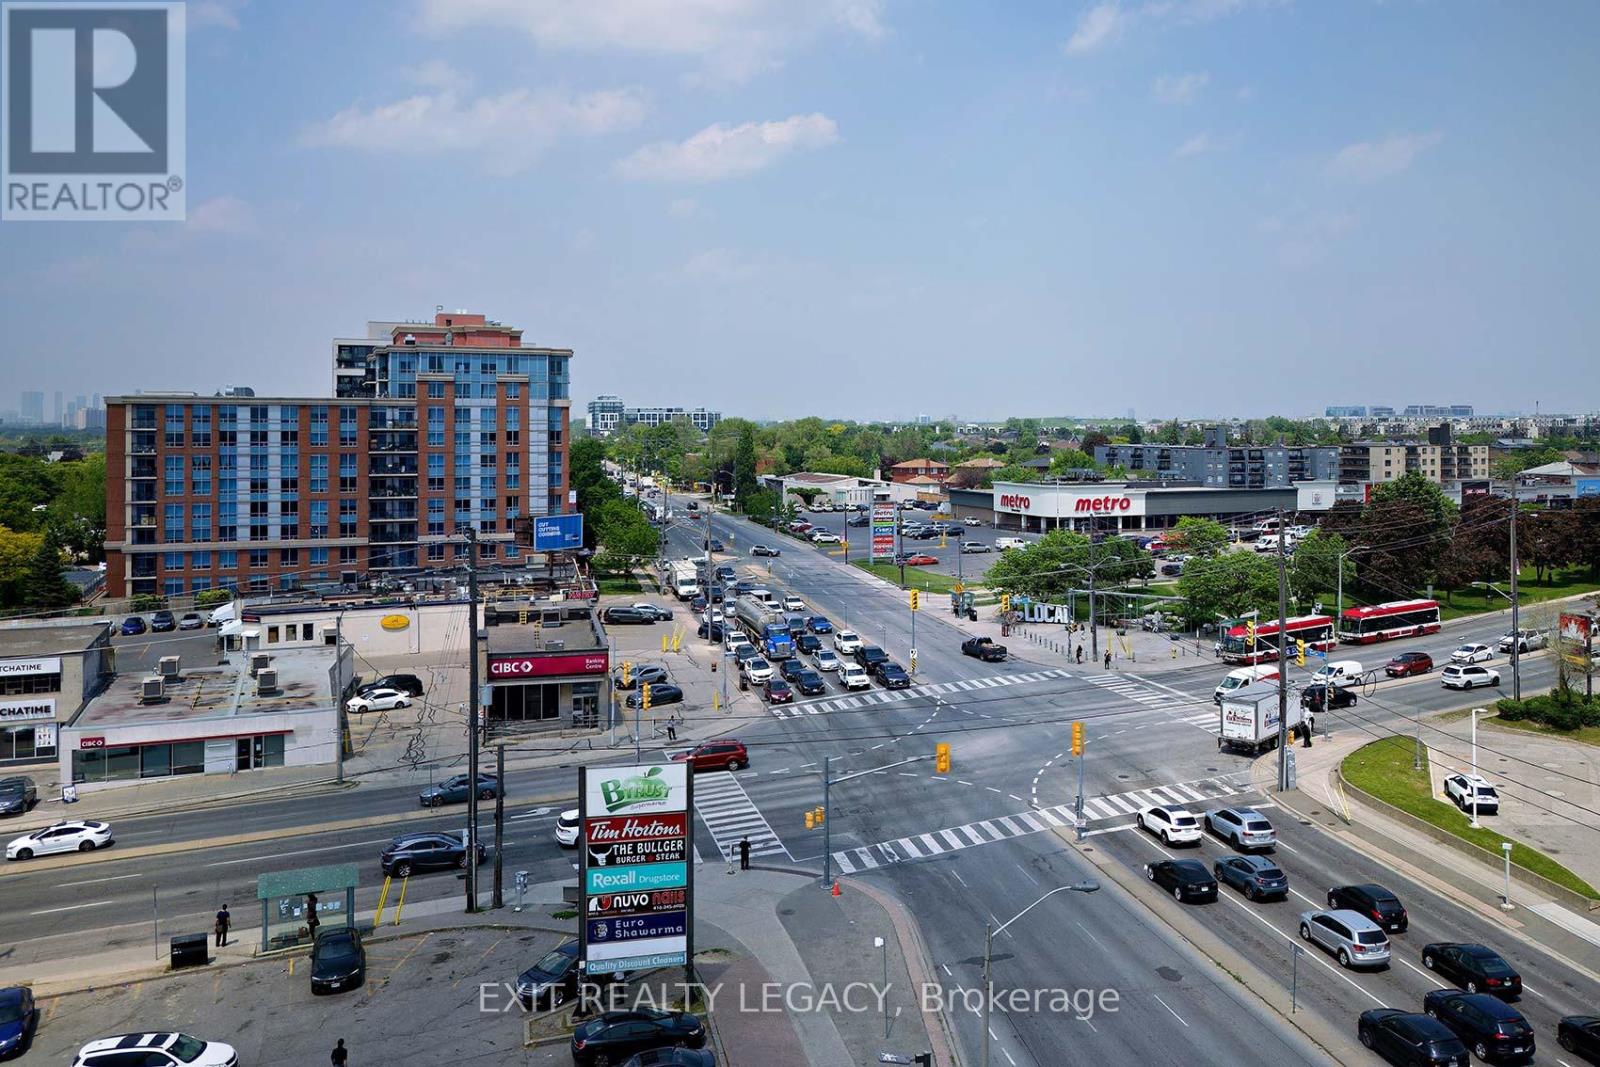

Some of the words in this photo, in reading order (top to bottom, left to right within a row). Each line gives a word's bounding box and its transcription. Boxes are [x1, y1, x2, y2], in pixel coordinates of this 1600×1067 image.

[1000, 494, 1030, 510] metro
[1075, 495, 1131, 512] metro
[1024, 603, 1070, 624] LOCAL
[491, 661, 520, 674] CIBC
[0, 705, 51, 716] CHATIME
[590, 821, 618, 841] Tim
[621, 819, 681, 838] Hortons
[612, 843, 633, 855] THE
[637, 840, 684, 853] BULLGER
[616, 855, 646, 864] BURGER
[655, 852, 680, 861] STEAK
[593, 871, 636, 888] Rexall
[639, 874, 680, 884] Drugstore
[613, 894, 649, 908] nuvo
[652, 890, 685, 905] nails
[615, 920, 644, 928] Euro
[615, 926, 683, 938] Shawarma
[589, 962, 617, 971] Quality
[618, 960, 650, 969] Discount
[652, 956, 684, 965] Cleaners
